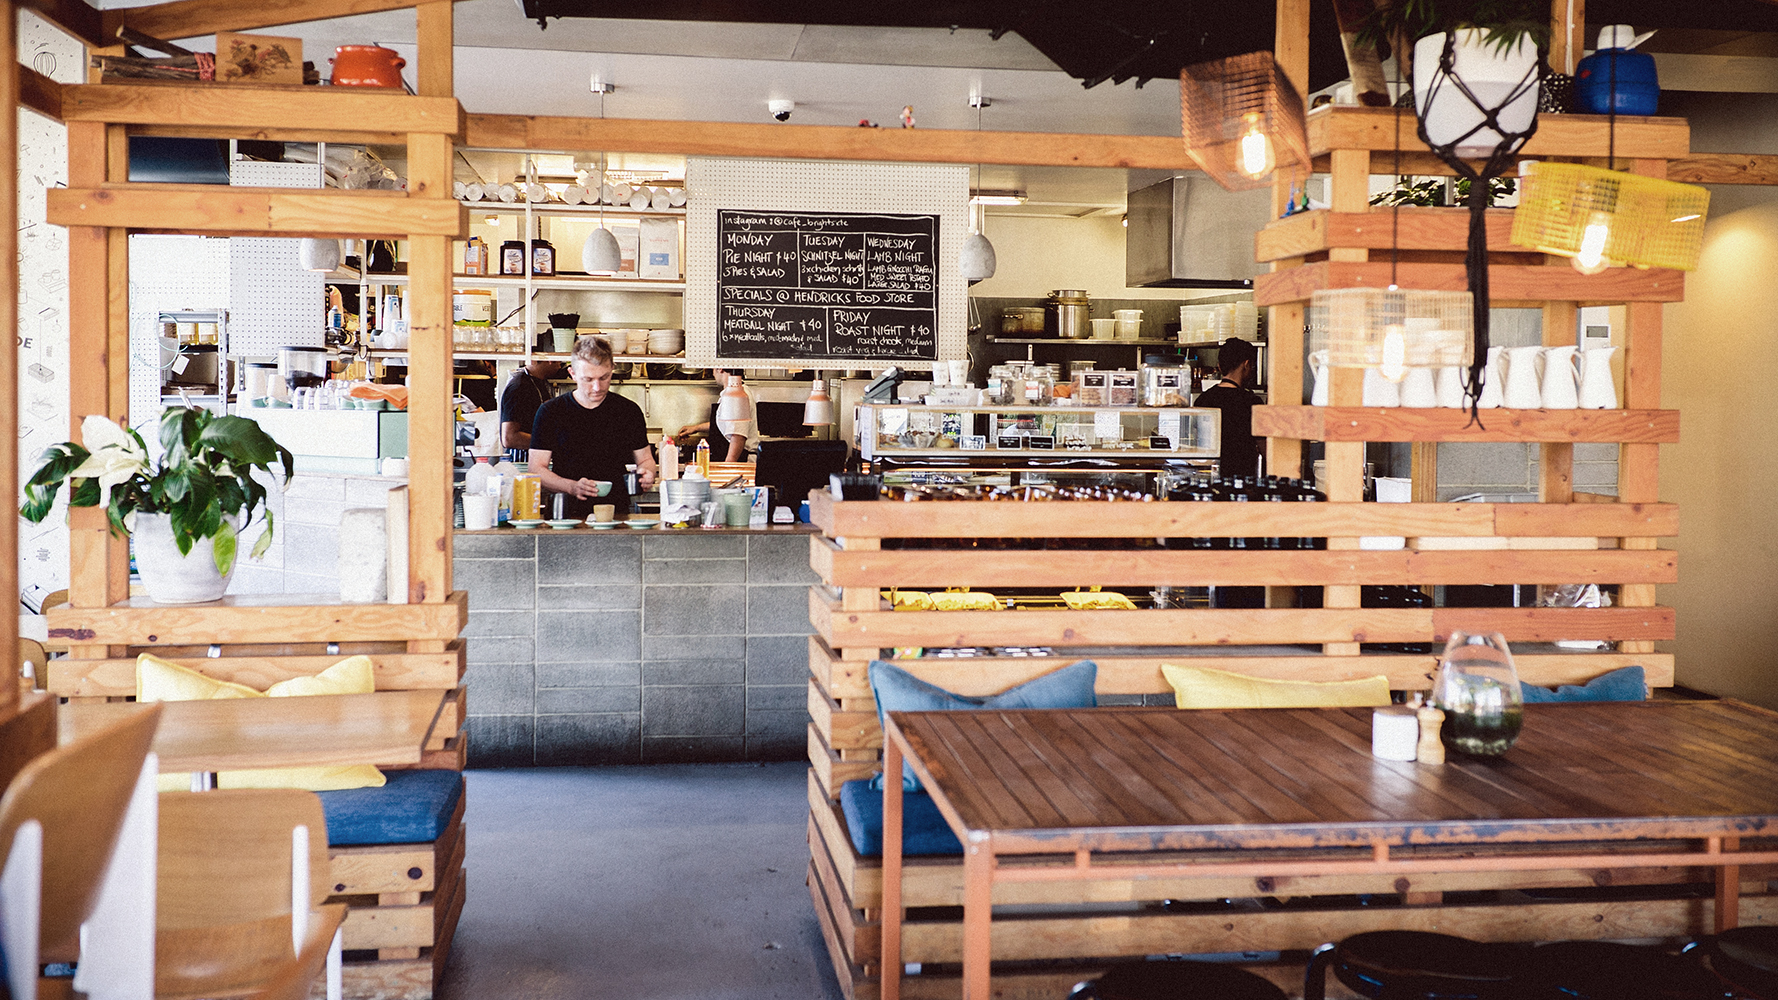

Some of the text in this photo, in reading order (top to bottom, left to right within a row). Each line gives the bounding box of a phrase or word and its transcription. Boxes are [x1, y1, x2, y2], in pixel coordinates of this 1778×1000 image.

[727, 233, 774, 247] MONDAY
[803, 234, 846, 248] TUESDAY
[867, 236, 917, 250] WEDNESDAY
[744, 251, 773, 263] NIGHT
[867, 250, 925, 263] LAMB NIGHT
[756, 267, 785, 278] SALAD
[867, 263, 887, 273] LAMB
[814, 273, 839, 284] SALAD
[723, 288, 915, 304] SPECIALS @ HENDRICKS FOOD STORE
[725, 305, 776, 319] THURSDAY
[833, 310, 871, 325] FRIDAY
[724, 319, 765, 332] MEATBALL
[767, 321, 795, 331] NIGHT
[834, 322, 870, 336] ROAST
[872, 324, 905, 336] NIGHT
